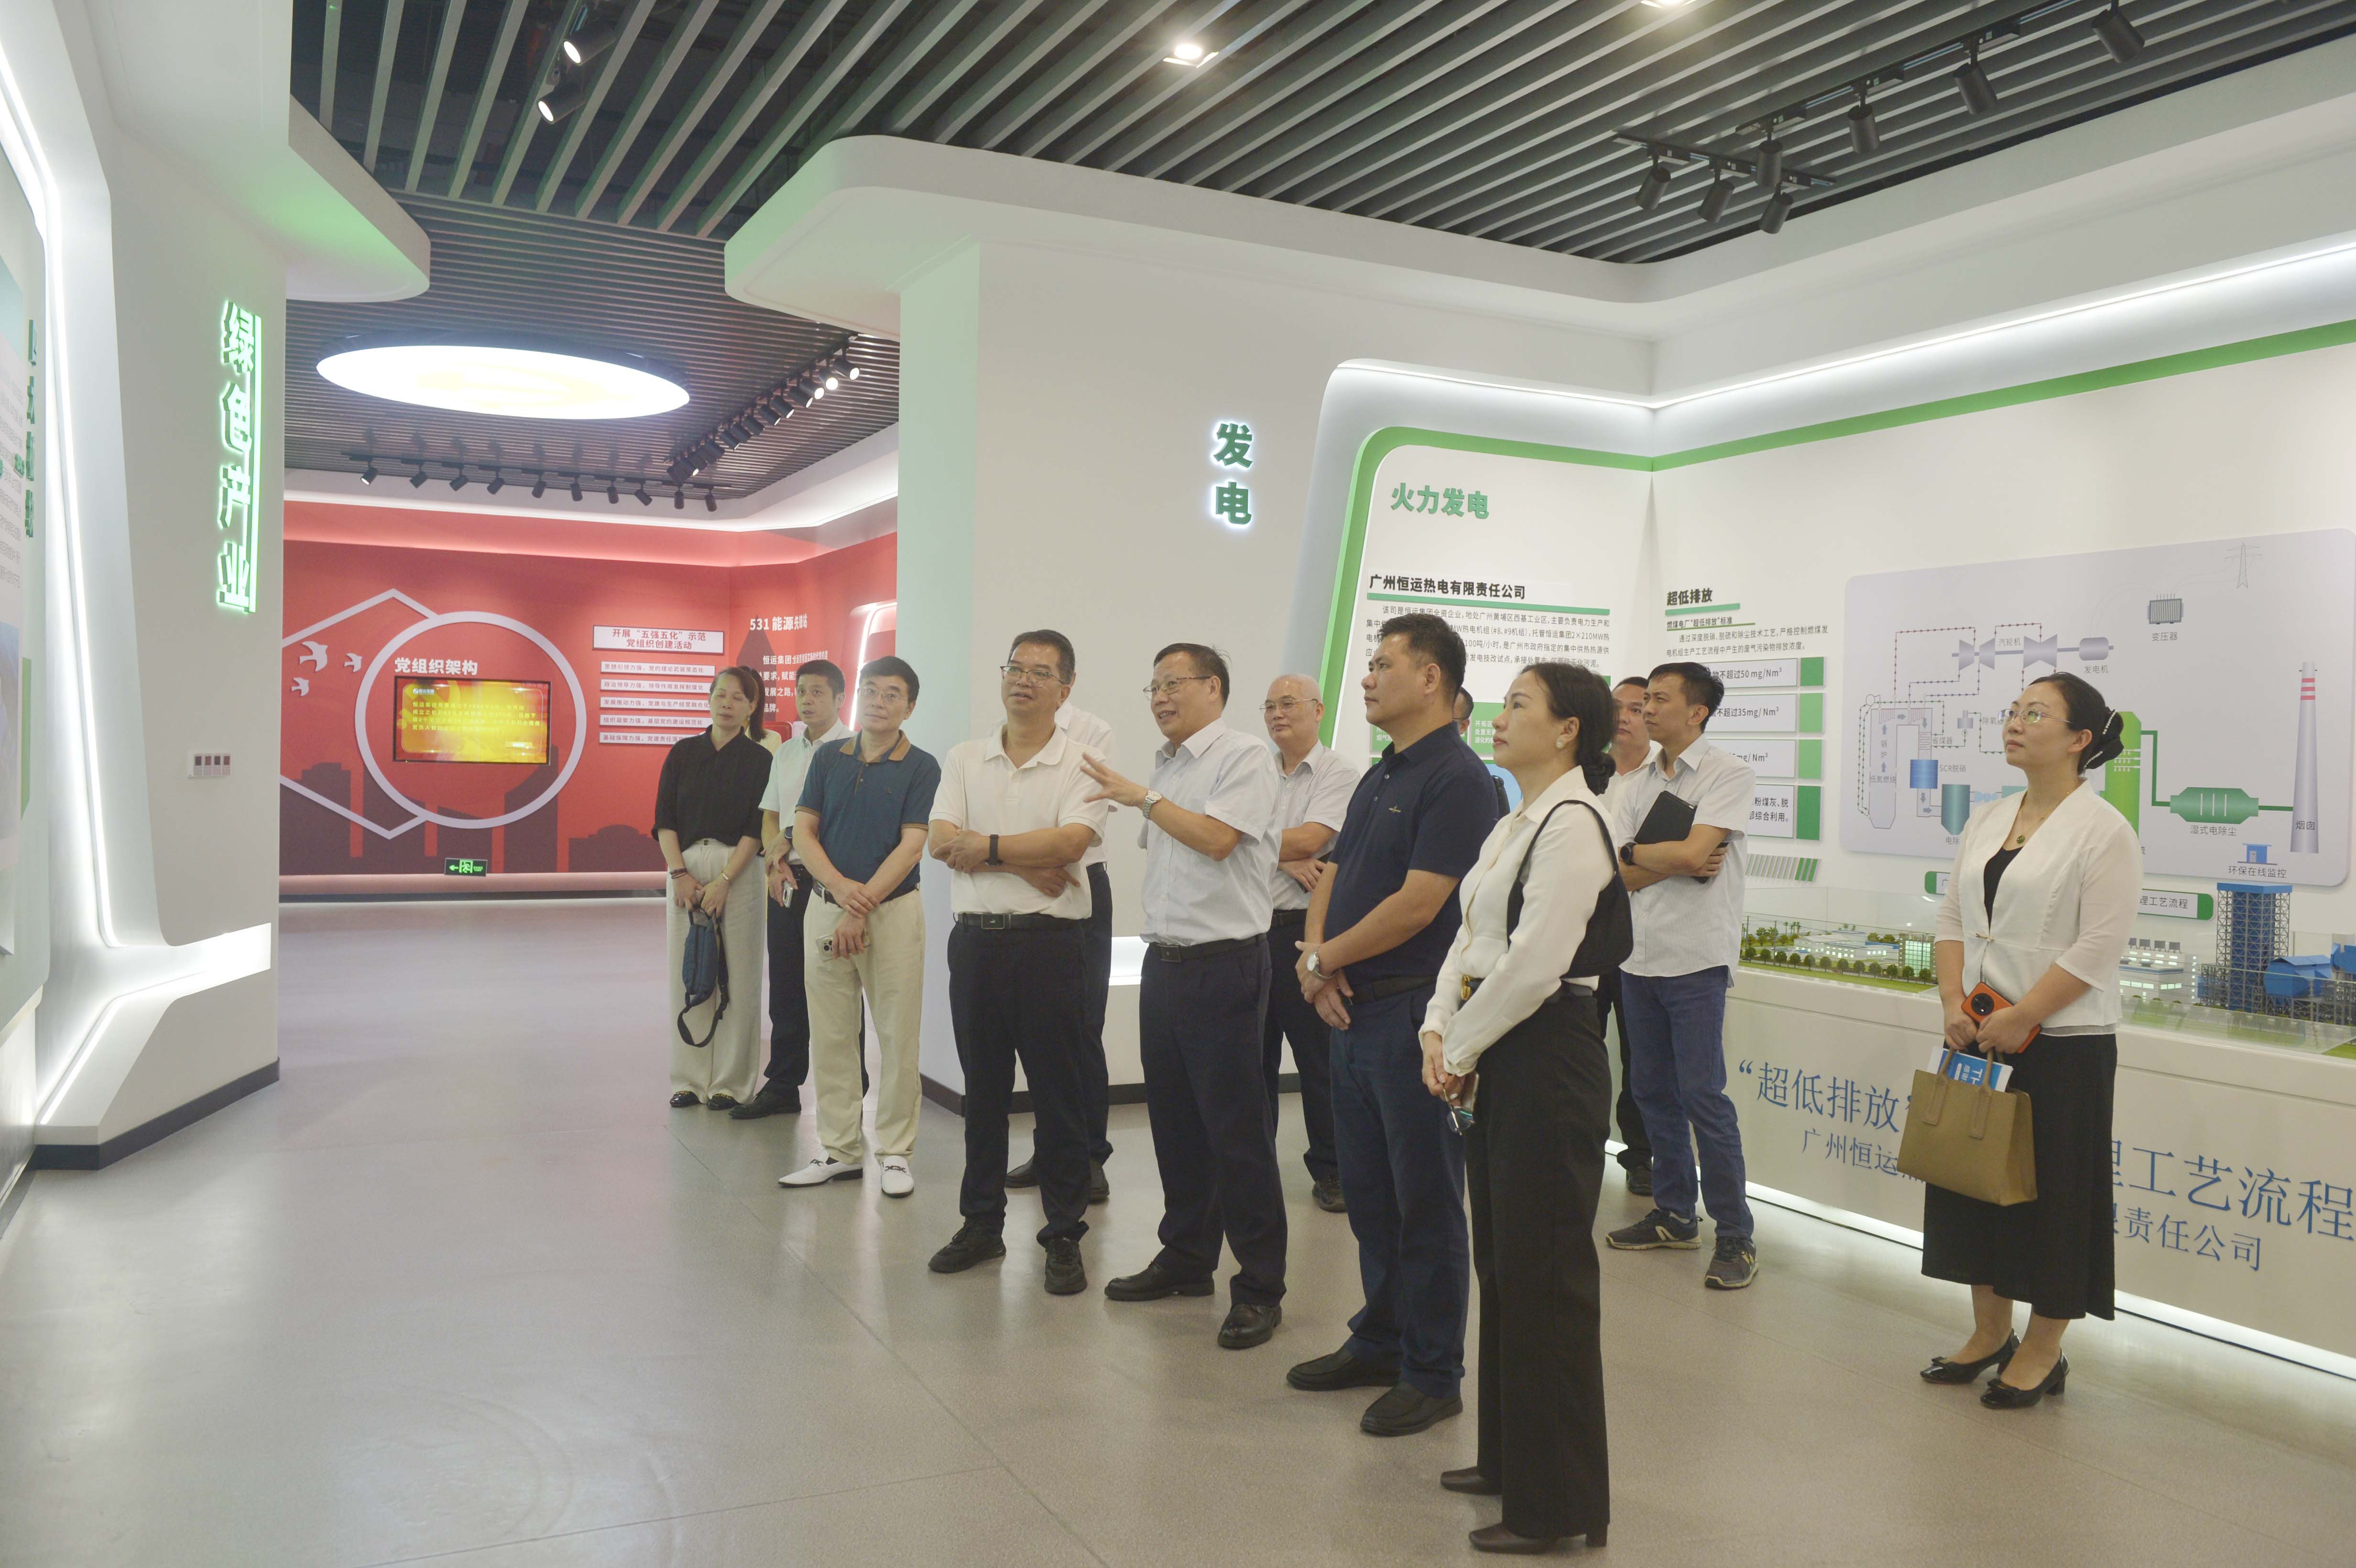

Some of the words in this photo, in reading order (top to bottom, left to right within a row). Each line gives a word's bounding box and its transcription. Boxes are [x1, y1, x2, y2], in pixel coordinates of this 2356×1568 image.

[218, 301, 255, 609] 绿色产业
[1213, 423, 1253, 525] 发电
[1391, 482, 1490, 520] 火力发电
[1369, 574, 1526, 599] 广州恒运热电有限责任公司
[1667, 588, 1712, 606] 超低排放
[1998, 638, 2021, 647] 汽轮机
[2151, 632, 2178, 641] 变压器
[627, 639, 692, 650] 党组织创建活动
[394, 657, 478, 675] 党组织架构
[2084, 665, 2108, 674] 发电机
[1939, 764, 1966, 773] SCR脱硝
[2191, 825, 2237, 837] 湿式电除尘
[2295, 820, 2315, 831] 烟囱
[2228, 865, 2287, 879] 环保在线监控
[1801, 1128, 1924, 1184] 广州恒运
